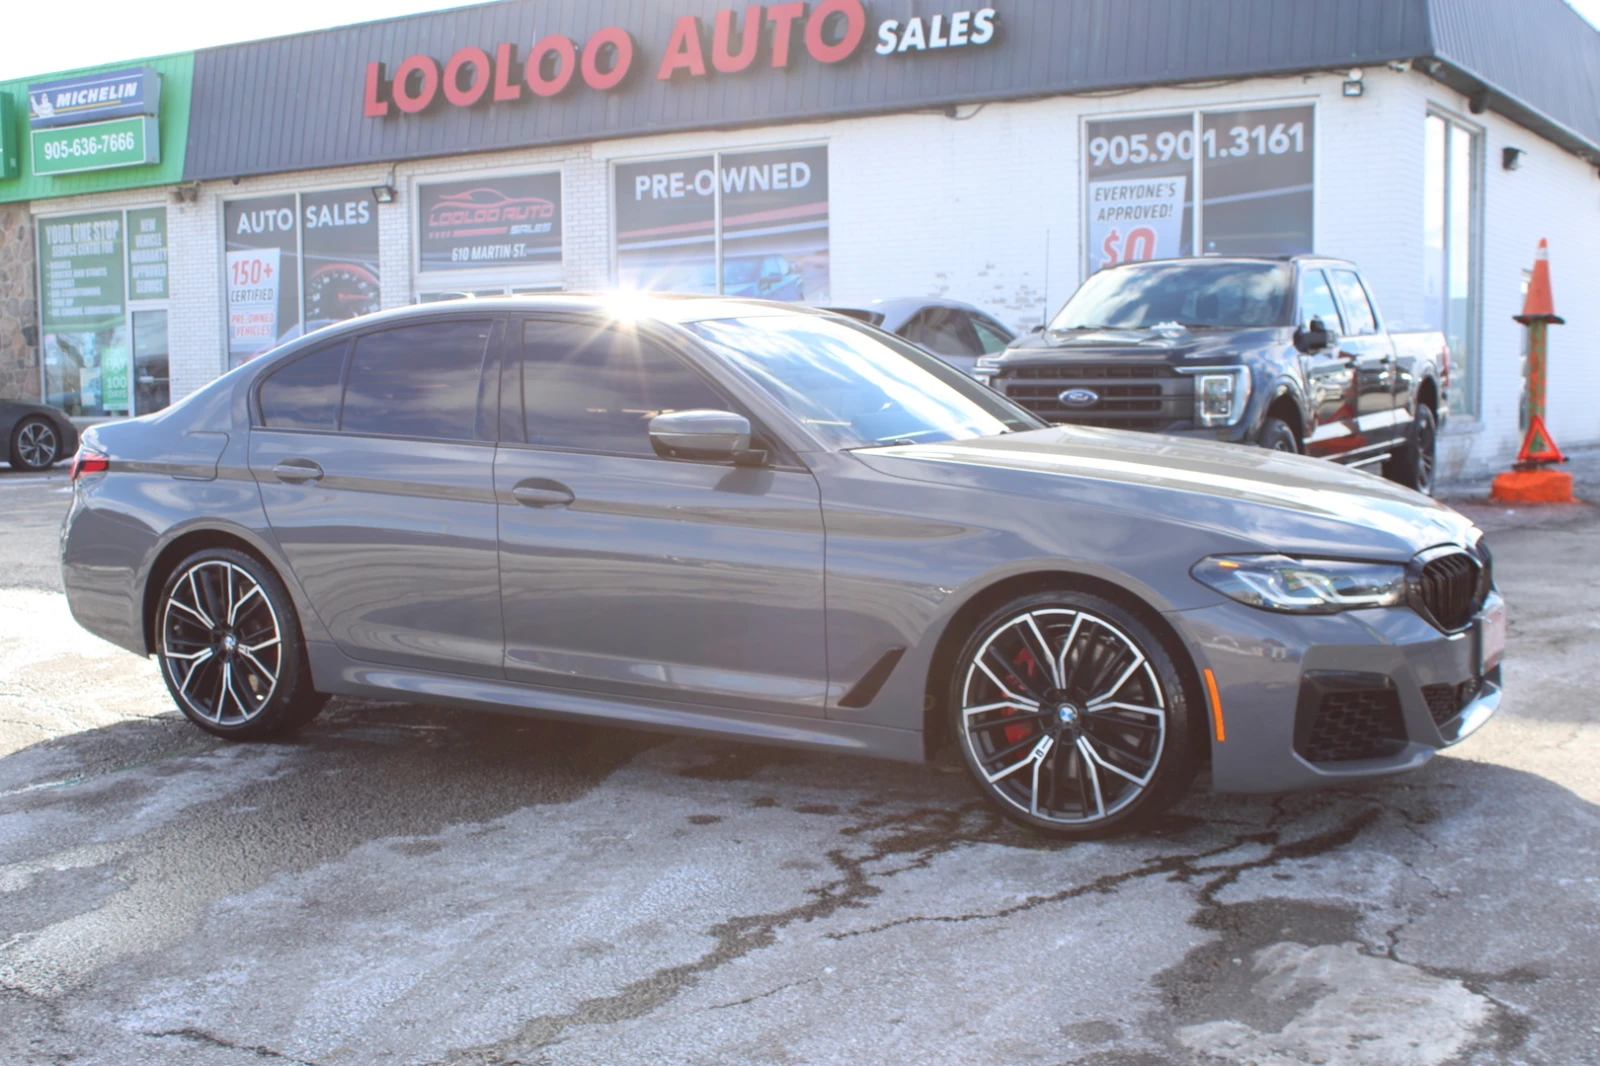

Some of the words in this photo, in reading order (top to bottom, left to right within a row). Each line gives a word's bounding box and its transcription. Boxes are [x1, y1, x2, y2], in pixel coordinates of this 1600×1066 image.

[363, 26, 633, 117] LOOLOO
[656, 0, 866, 80] AUTO
[875, 8, 996, 55] SALES
[56, 82, 138, 108] MICHELIN
[44, 131, 135, 160] 905-636-7666
[1089, 122, 1304, 167] 905.901.3161
[635, 161, 811, 201] PRE-OWNED
[1095, 182, 1177, 202] EVERYONE'S
[236, 208, 293, 234] AUTO
[306, 200, 370, 229] SALES
[428, 208, 501, 227] LOOLOO
[502, 203, 554, 222] AUTO
[1097, 204, 1174, 222] APPROVED!
[45, 223, 72, 245] YOUR
[93, 219, 119, 241] STOP
[510, 222, 552, 235] SALES
[451, 246, 470, 262] 610
[471, 244, 511, 260] MARTIN
[512, 243, 527, 258] ST.
[1102, 226, 1156, 268] $0
[231, 258, 273, 286] 150+
[230, 288, 274, 303] CERTIFIED
[230, 312, 274, 325] PRE-OWNED
[236, 324, 271, 337] VEHICLES
